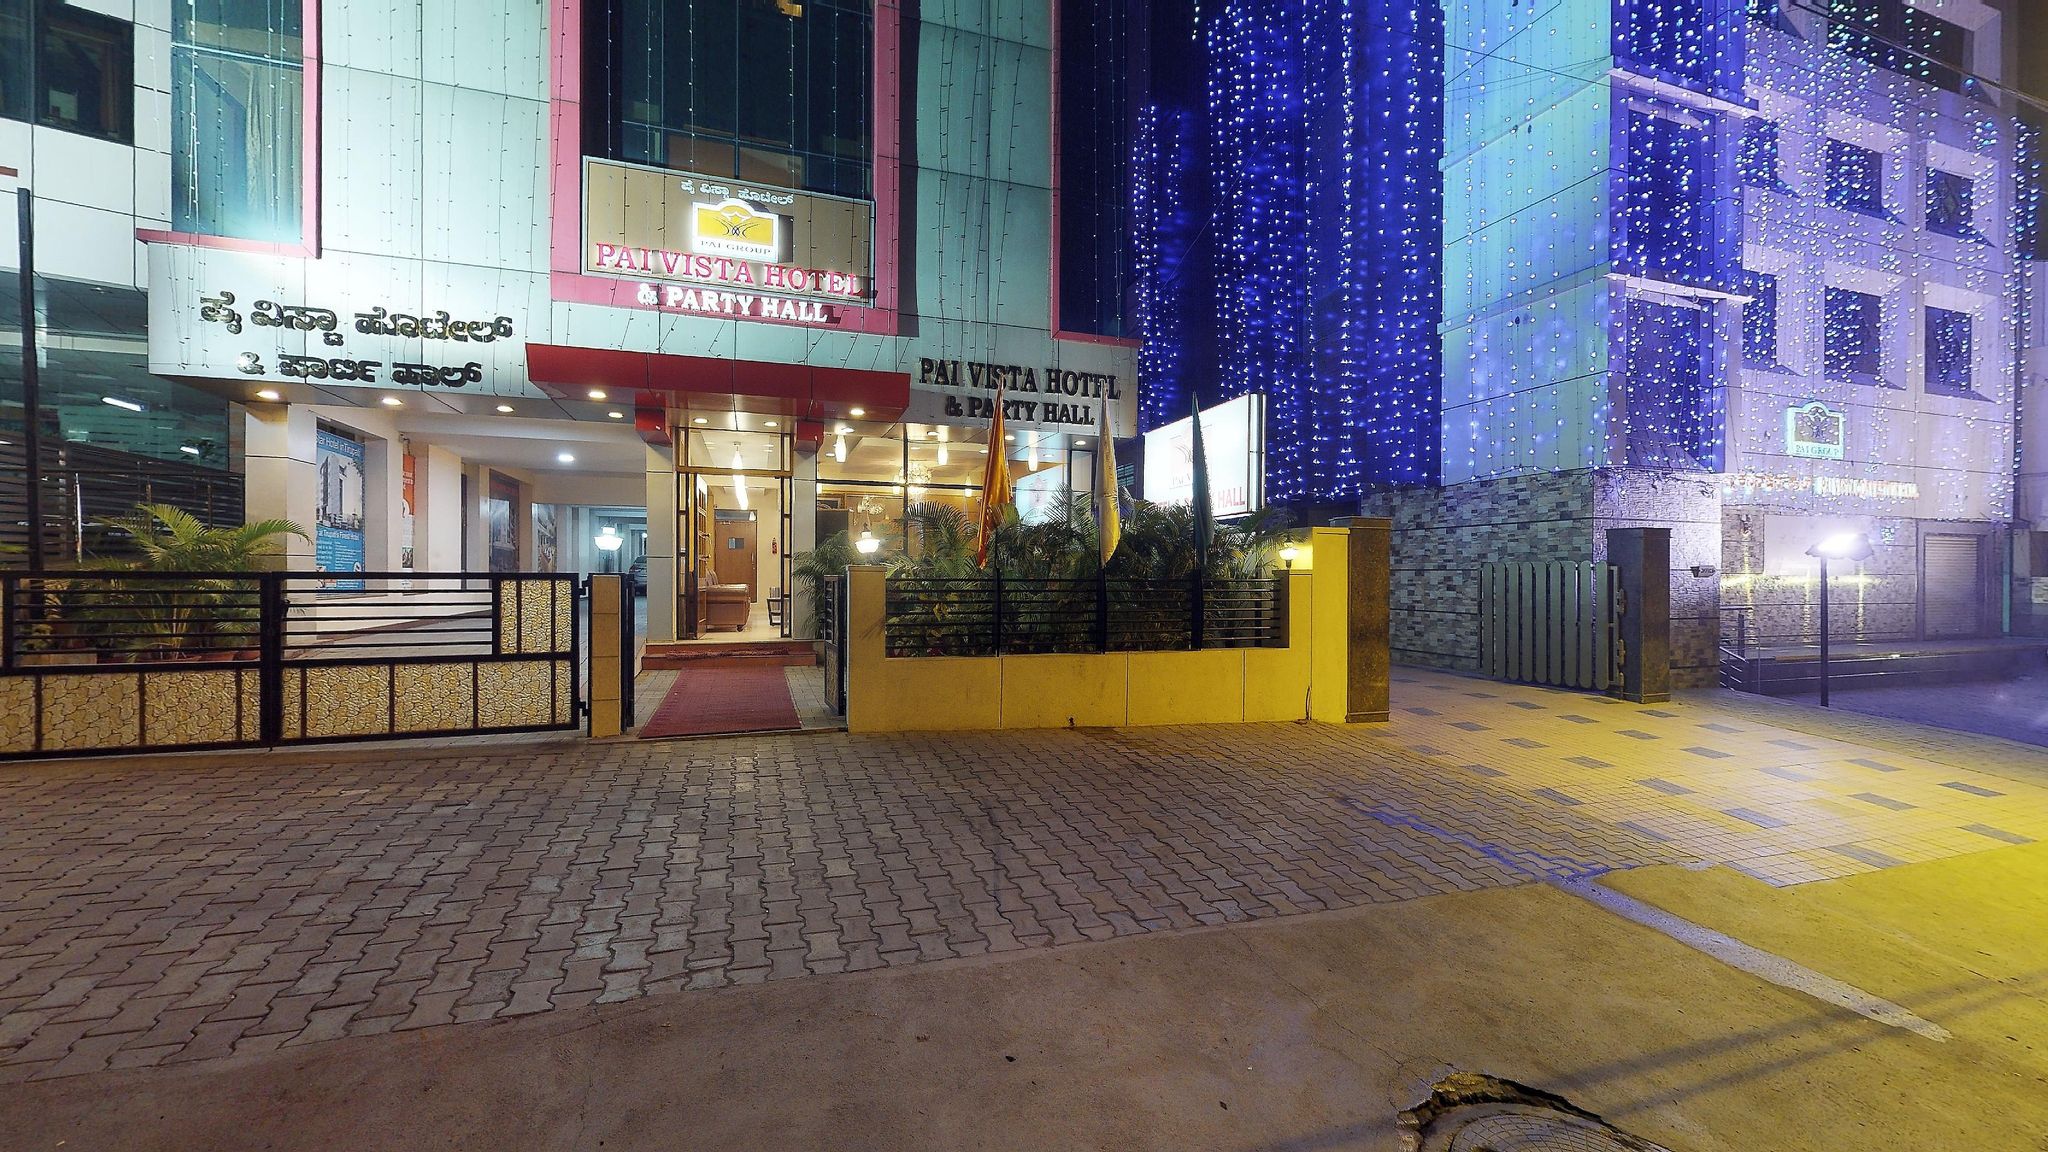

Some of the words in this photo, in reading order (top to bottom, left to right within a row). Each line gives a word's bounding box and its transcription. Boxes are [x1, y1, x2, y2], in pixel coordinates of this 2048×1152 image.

[701, 240, 721, 249] PAI
[726, 244, 772, 256] GROUP
[596, 243, 652, 274] PAI
[658, 251, 755, 285] VISTA
[763, 263, 864, 298] HOTEL
[199, 290, 243, 335] ಪೈ
[250, 299, 344, 347] ವಿಸ್ಟಾ
[637, 284, 658, 305] &
[666, 285, 754, 317] PARTY
[760, 297, 828, 323] HALL
[237, 351, 266, 376] &
[392, 362, 483, 388] ಹಾಲ್
[919, 357, 960, 386] PAI
[967, 361, 1039, 393] VISTA
[945, 395, 964, 417] &
[967, 396, 1039, 422] PARTY
[1043, 402, 1095, 426] HALL
[1217, 486, 1246, 509] HALL
